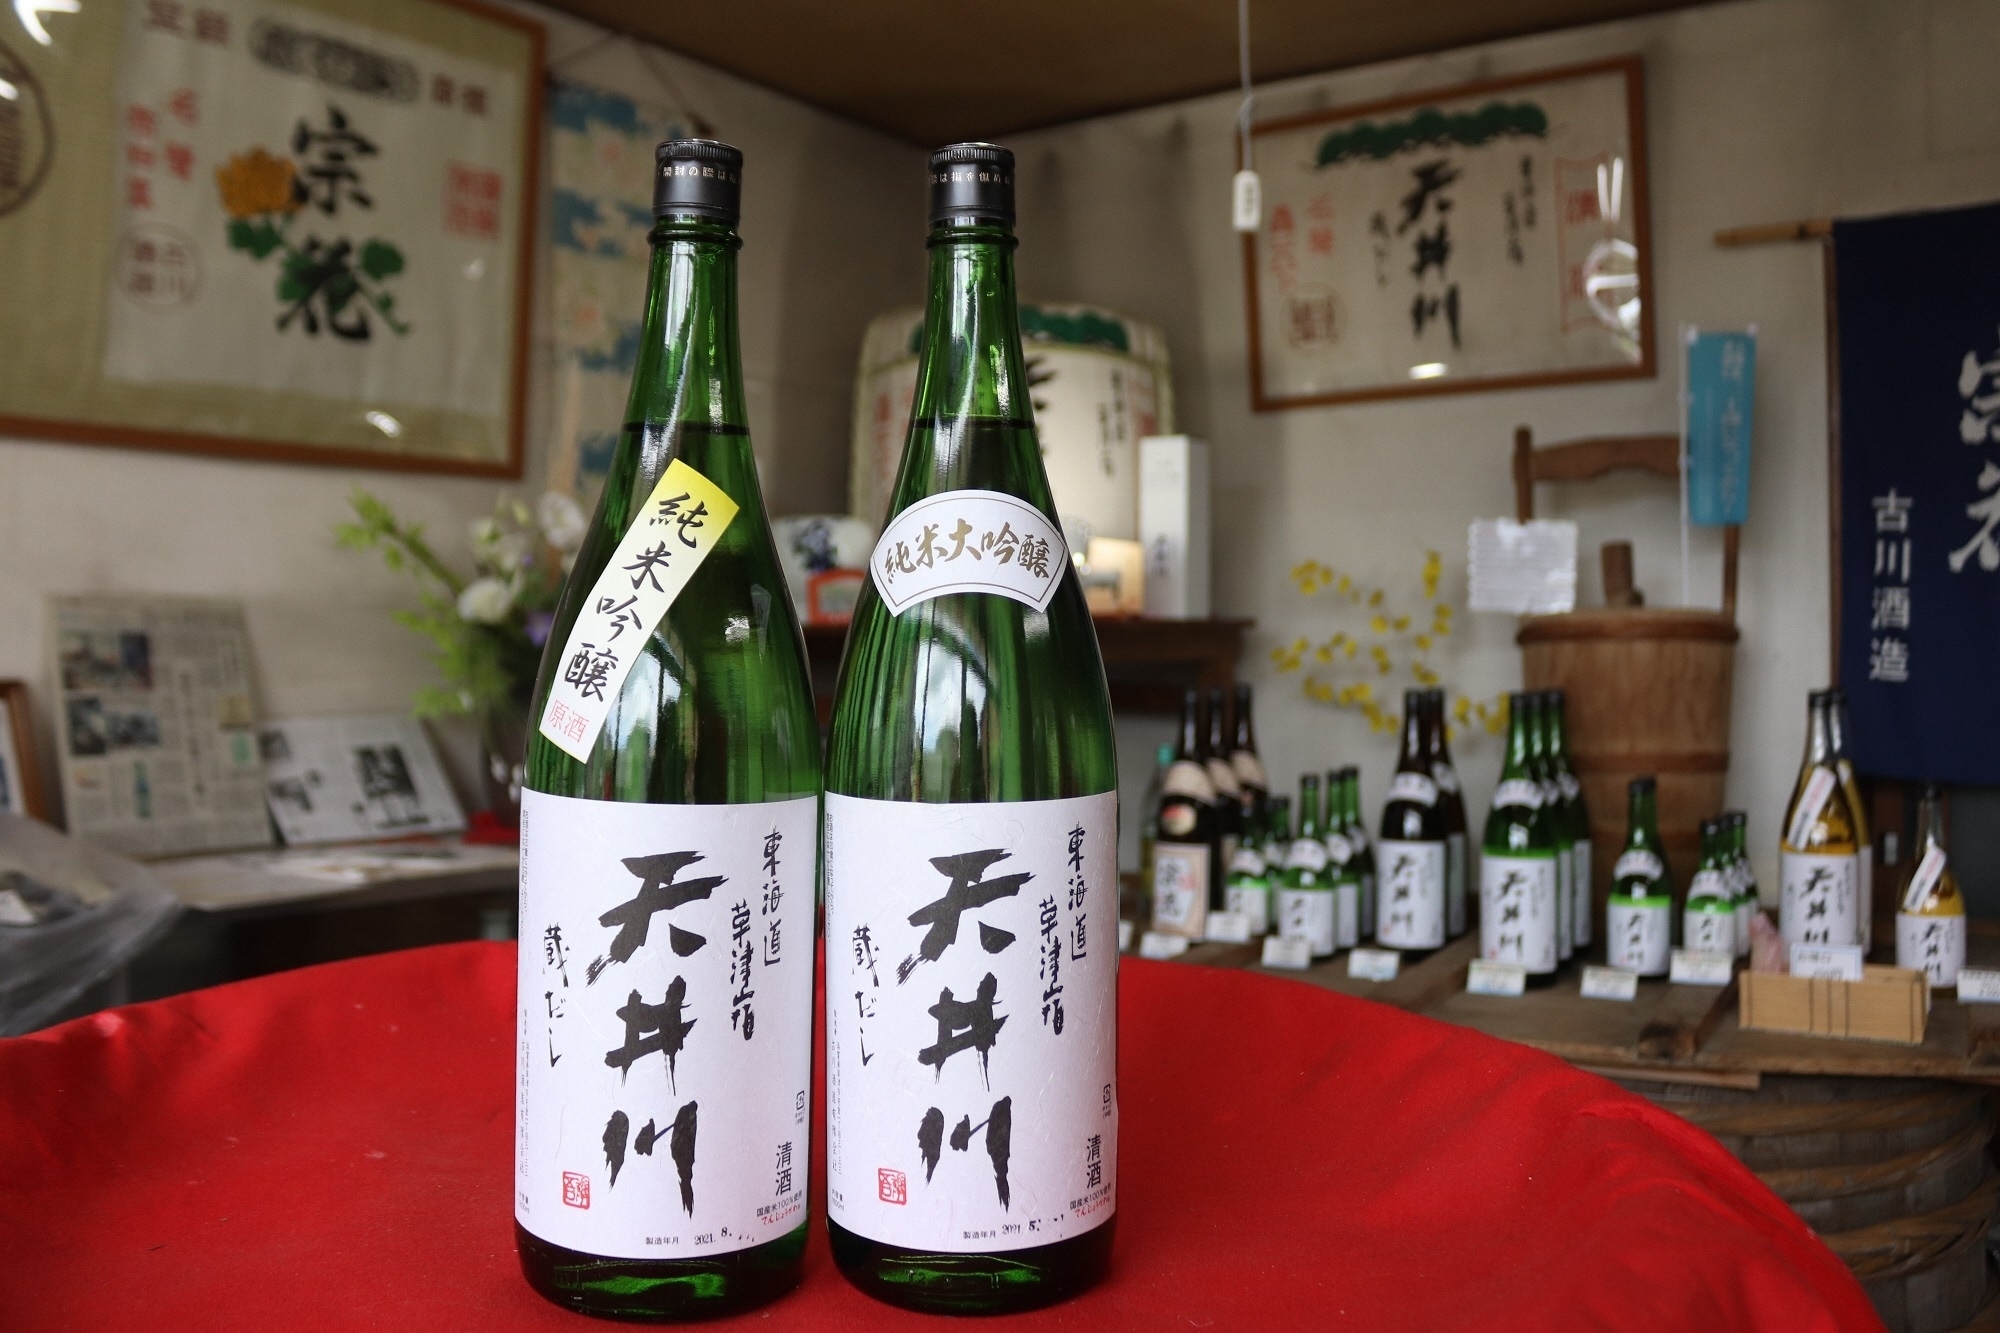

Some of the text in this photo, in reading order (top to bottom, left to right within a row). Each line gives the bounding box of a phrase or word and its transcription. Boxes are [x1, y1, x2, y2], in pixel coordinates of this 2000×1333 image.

[1396, 160, 1464, 350] 天井川
[564, 492, 708, 703] 純米吟醸
[885, 518, 1050, 585] 純米大吟醸
[1869, 488, 1914, 683] 古川酒造
[547, 698, 590, 743] 原酒
[763, 826, 786, 967] 東海道
[1067, 822, 1089, 962] 東海道
[1499, 870, 1528, 963] 天井川
[542, 921, 569, 1068] 蔵だし
[585, 850, 729, 1219] 天井川
[852, 922, 879, 1067] 蔵だし
[896, 848, 1037, 1213] 天井川
[775, 1141, 792, 1197] 清酒
[1086, 1134, 1102, 1189] 清酒
[645, 1236, 679, 1245] 製造年月
[963, 1230, 996, 1239] 製造年月
